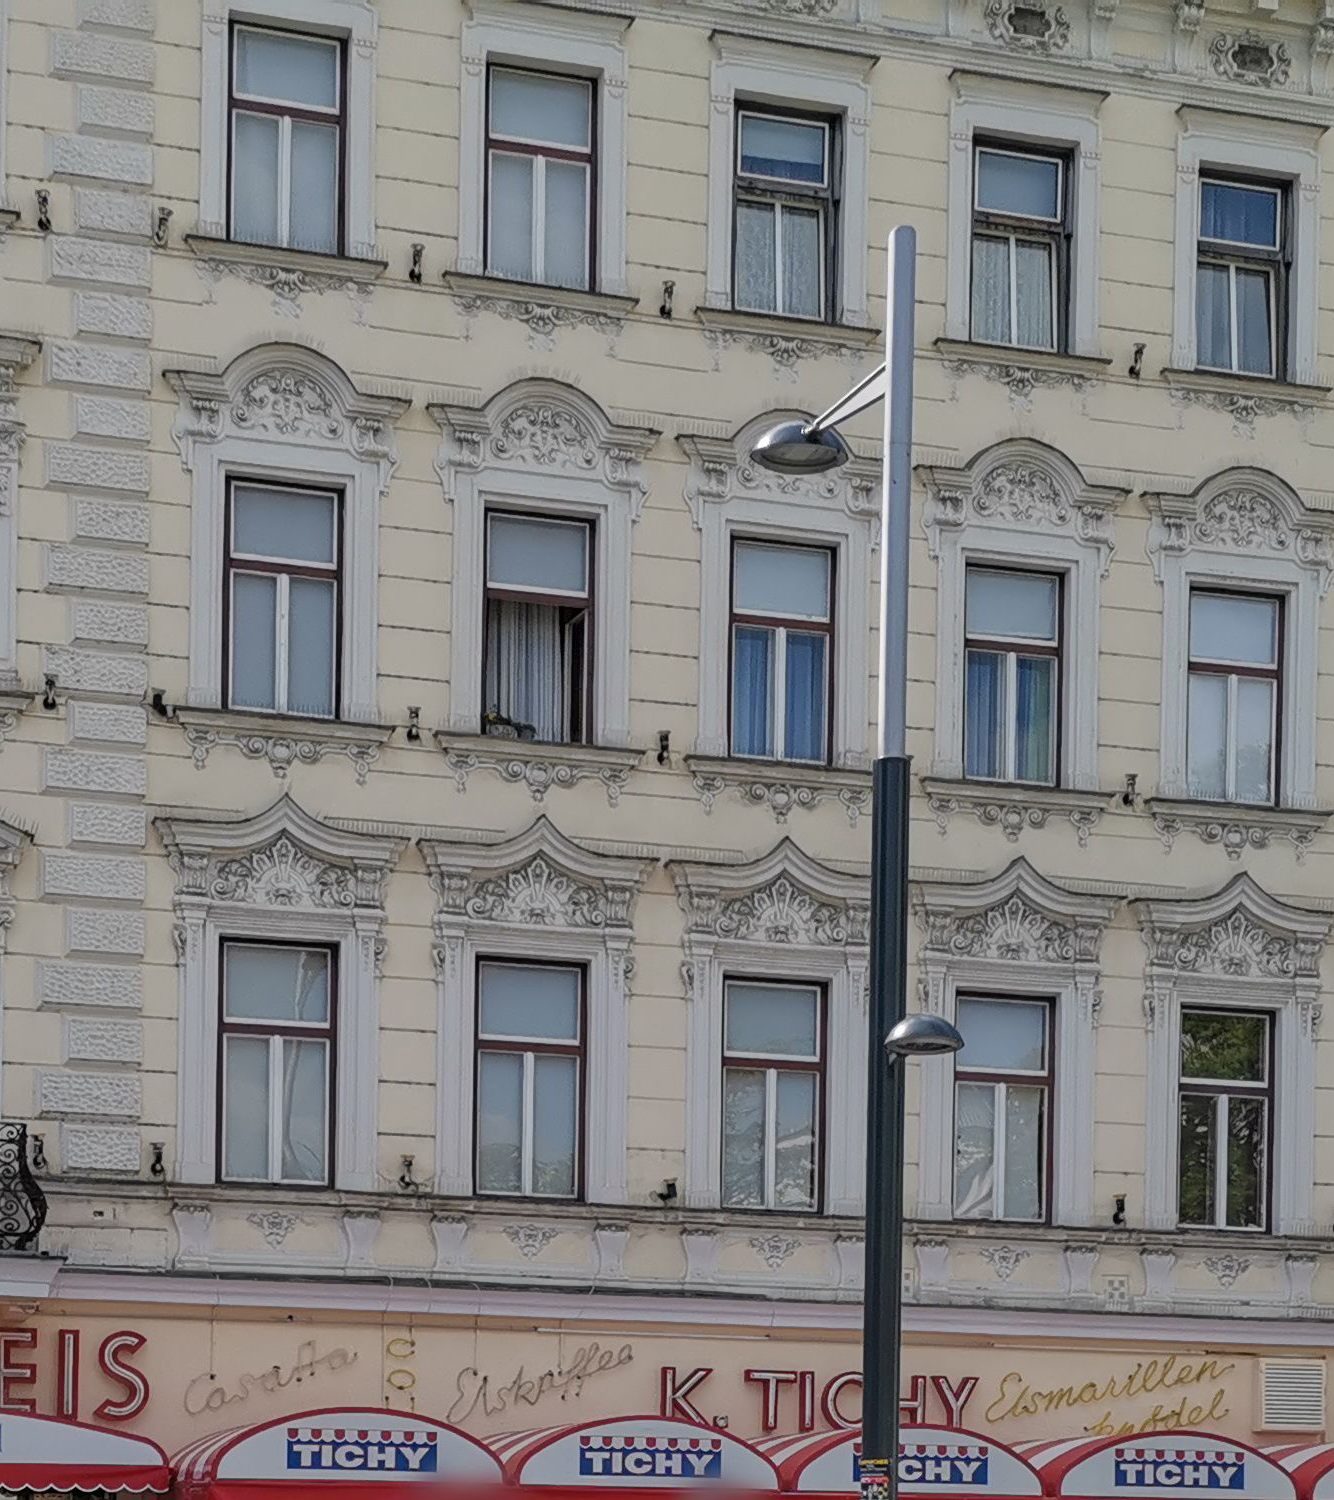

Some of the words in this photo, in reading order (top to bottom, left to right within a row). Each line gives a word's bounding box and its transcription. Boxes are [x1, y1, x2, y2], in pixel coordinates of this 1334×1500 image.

[661, 1366, 728, 1429] K.
[744, 1368, 980, 1431] TICHY
[293, 1442, 434, 1471] TICHY
[584, 1451, 715, 1477] TICHY
[897, 1459, 983, 1482] CHY
[1119, 1461, 1238, 1488] TICHY
